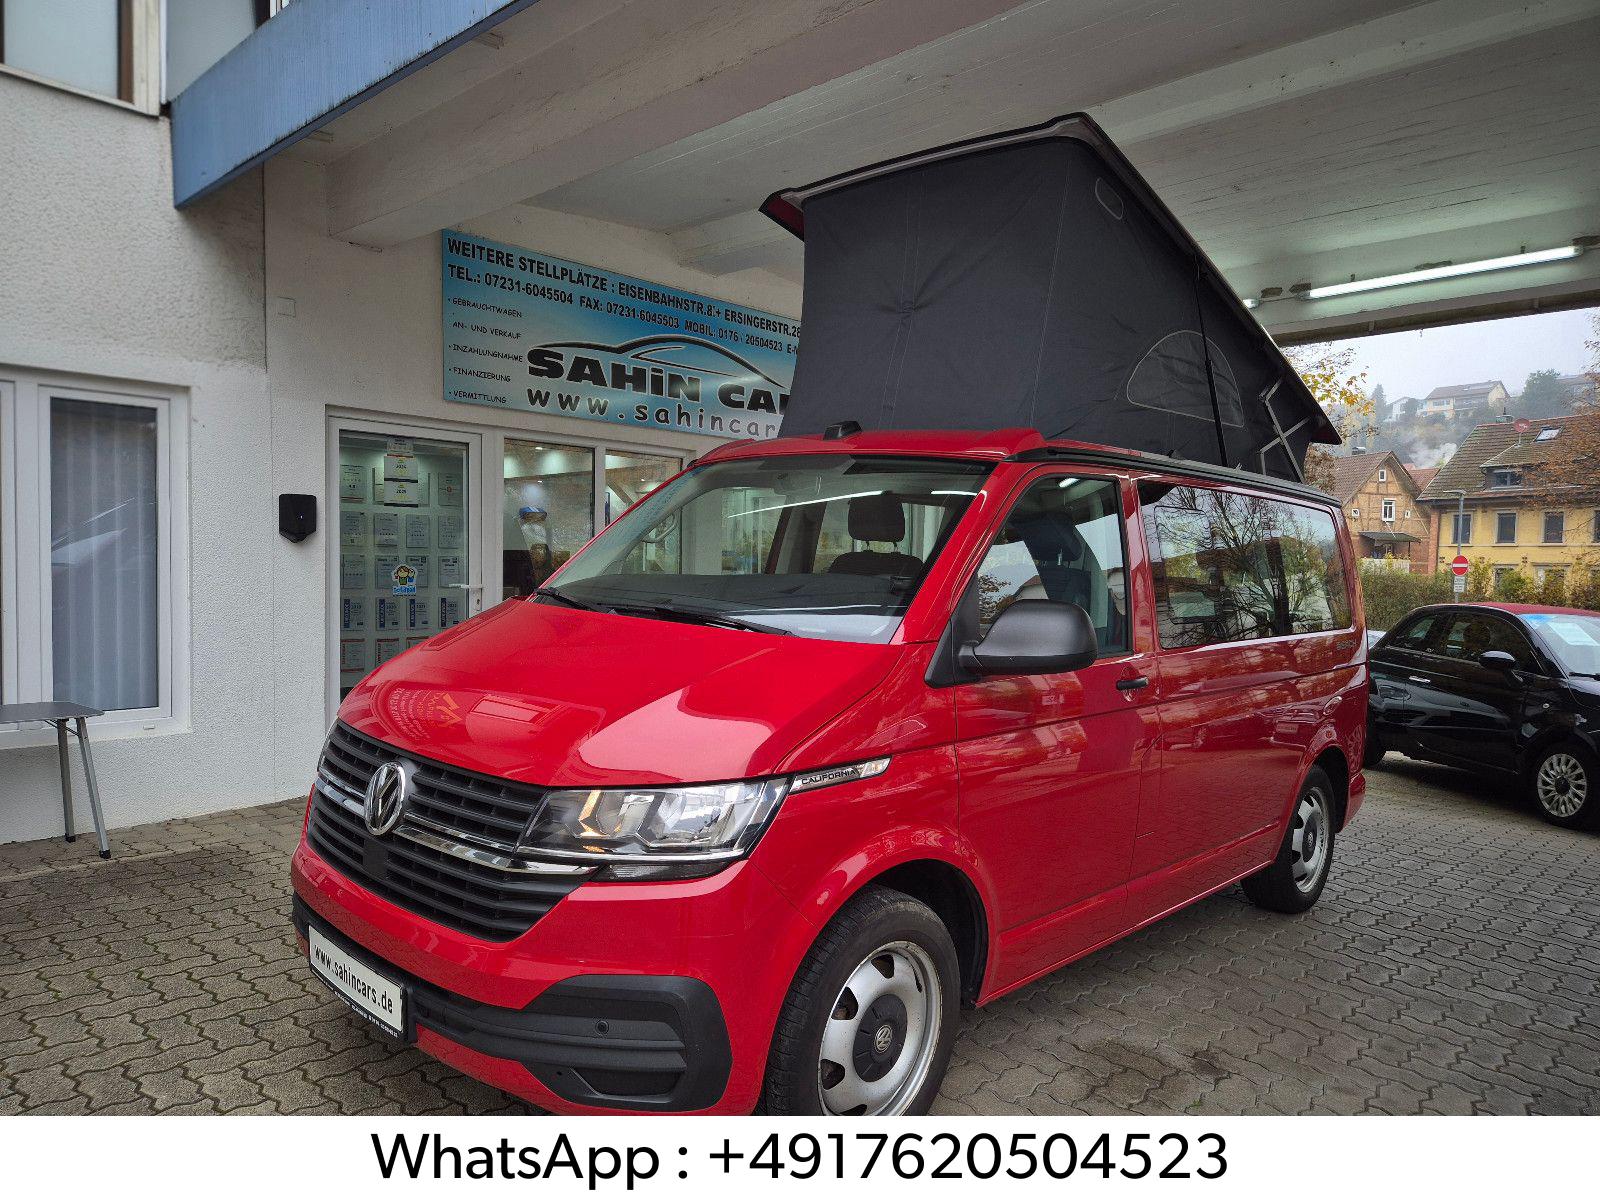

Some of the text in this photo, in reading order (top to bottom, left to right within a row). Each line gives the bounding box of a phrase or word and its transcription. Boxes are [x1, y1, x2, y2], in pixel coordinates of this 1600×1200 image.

[447, 237, 515, 269] WEITERE
[518, 256, 608, 292] STELLPLÄTZE
[447, 263, 481, 284] TEL.:
[484, 272, 573, 304] 07231-6045504
[579, 295, 603, 312] FAX:
[606, 301, 680, 329] 07231-6045503
[684, 319, 716, 338] MOBIL:
[745, 333, 783, 352] 20504523
[452, 297, 523, 319] GEBRAUCHTWAGEN
[470, 324, 488, 335] UND
[490, 327, 522, 341] VERKAUF
[453, 366, 512, 383] FINANZIERUNG
[453, 390, 507, 405] VERMITTLUNG
[801, 768, 856, 786] CALIFORNIA
[314, 944, 394, 1015] www.sahincars.de
